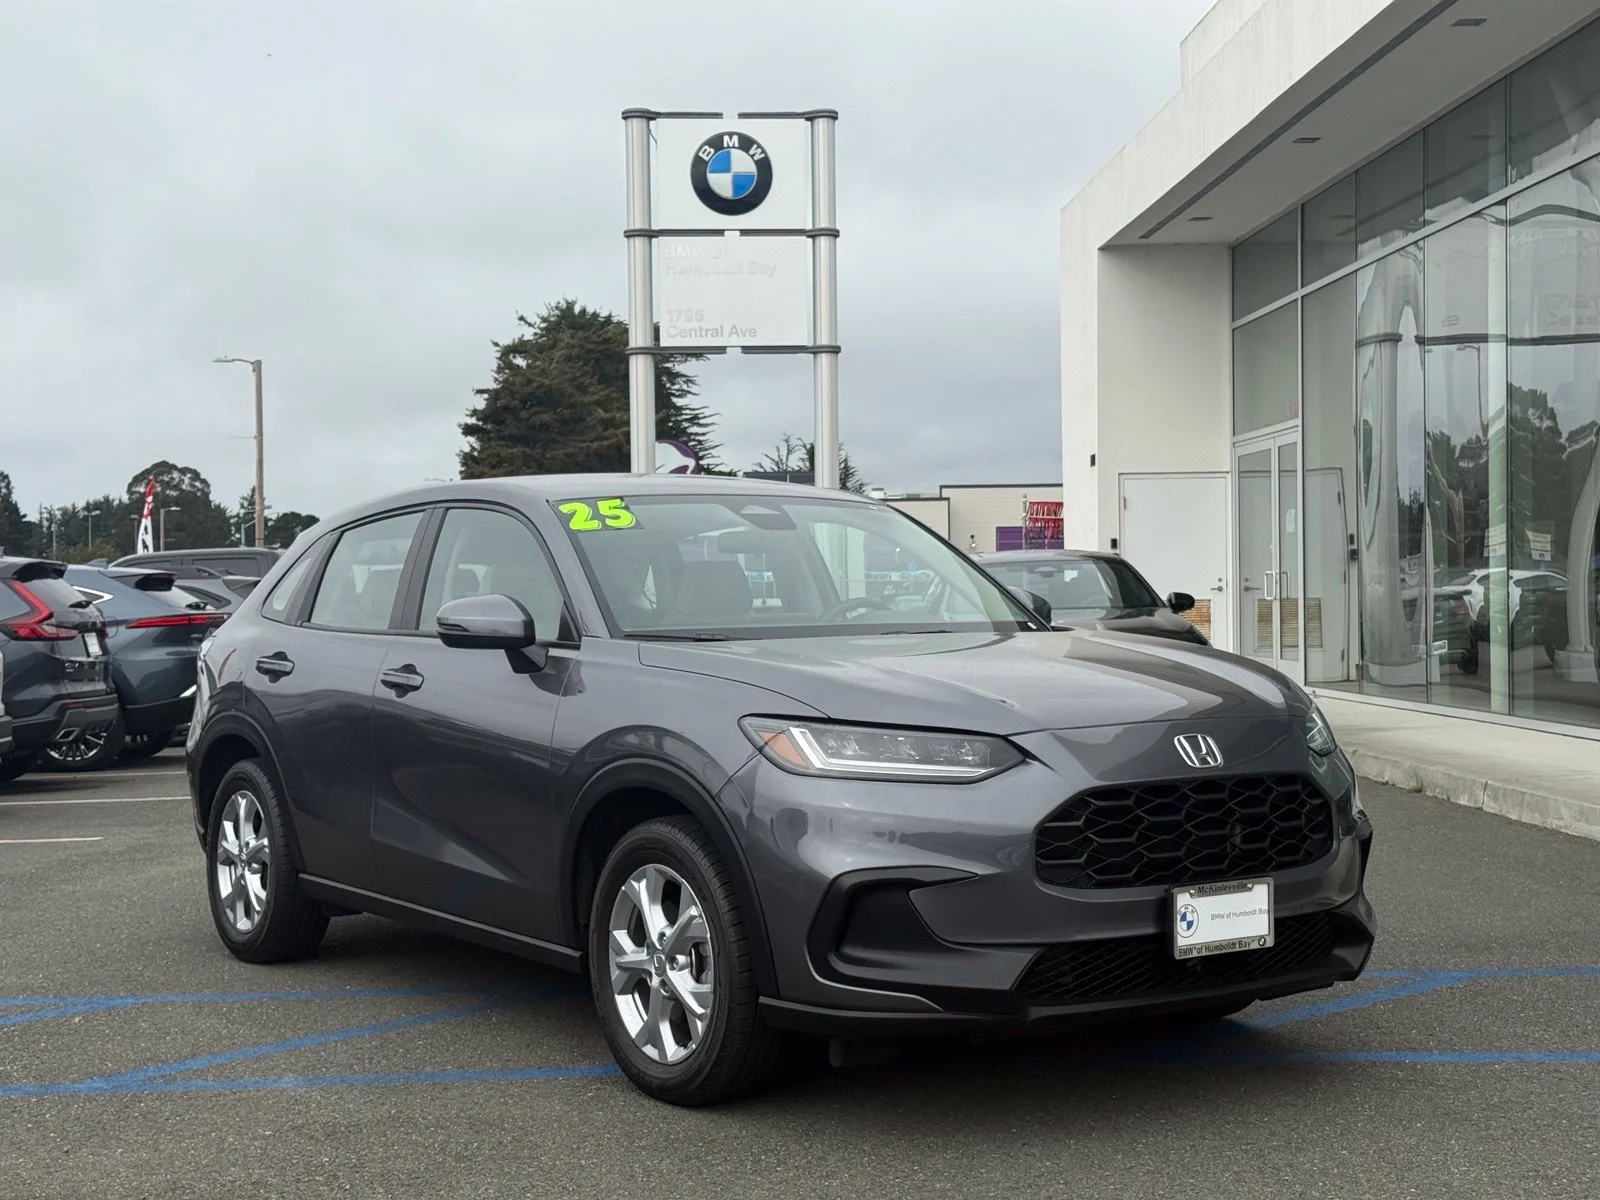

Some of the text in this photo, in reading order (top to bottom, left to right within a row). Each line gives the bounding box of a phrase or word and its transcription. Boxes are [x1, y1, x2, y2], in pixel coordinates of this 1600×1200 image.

[698, 135, 766, 161] BMW
[666, 324, 758, 338] Central Ave
[558, 498, 636, 531] 25
[1197, 882, 1248, 894] McKinleyville
[1210, 912, 1225, 921] BMW
[1232, 908, 1257, 919] Humboldt
[1204, 941, 1236, 953] Humboldt
